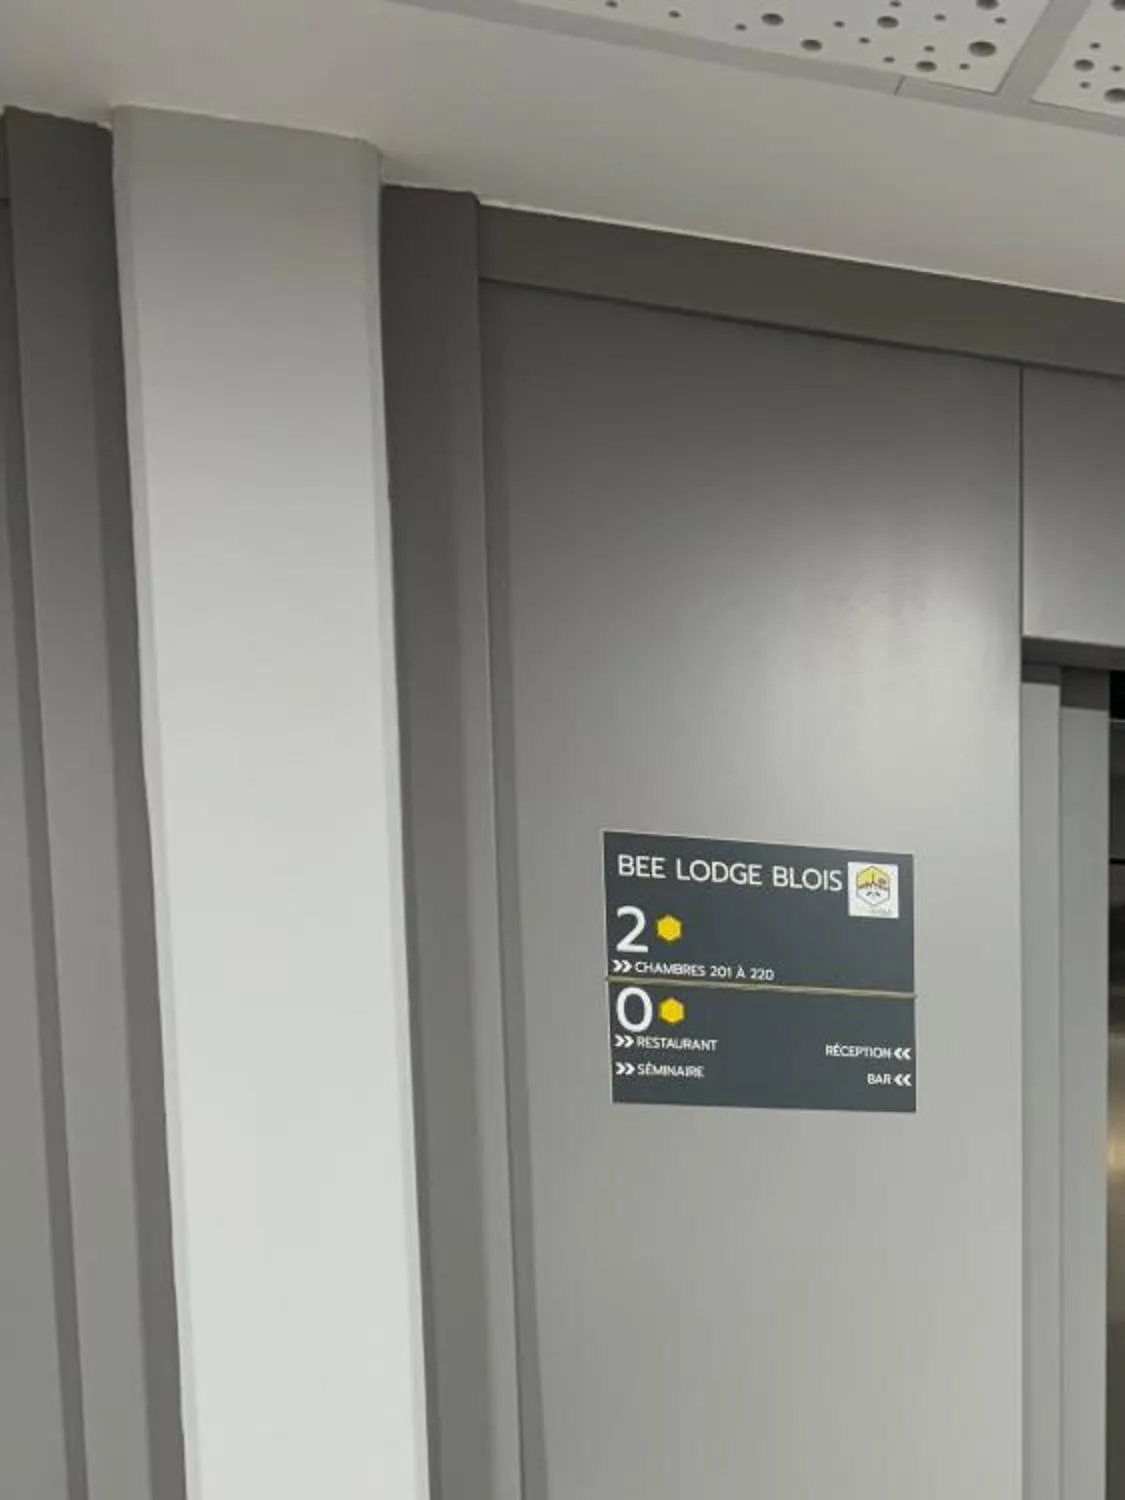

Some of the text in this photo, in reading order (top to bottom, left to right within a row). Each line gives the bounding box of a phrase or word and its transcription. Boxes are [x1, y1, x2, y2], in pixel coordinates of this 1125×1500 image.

[617, 854, 843, 891] BEE LODGE BLOIS
[616, 905, 649, 953] 2
[635, 961, 705, 977] CHAMBRES
[710, 965, 733, 978] 201
[616, 987, 653, 1032] 0
[636, 1036, 718, 1051] RESTAURANT
[825, 1042, 892, 1060] RÉCEPTION
[637, 1061, 705, 1078] SÉMINAIRE
[867, 1073, 892, 1085] BAR
